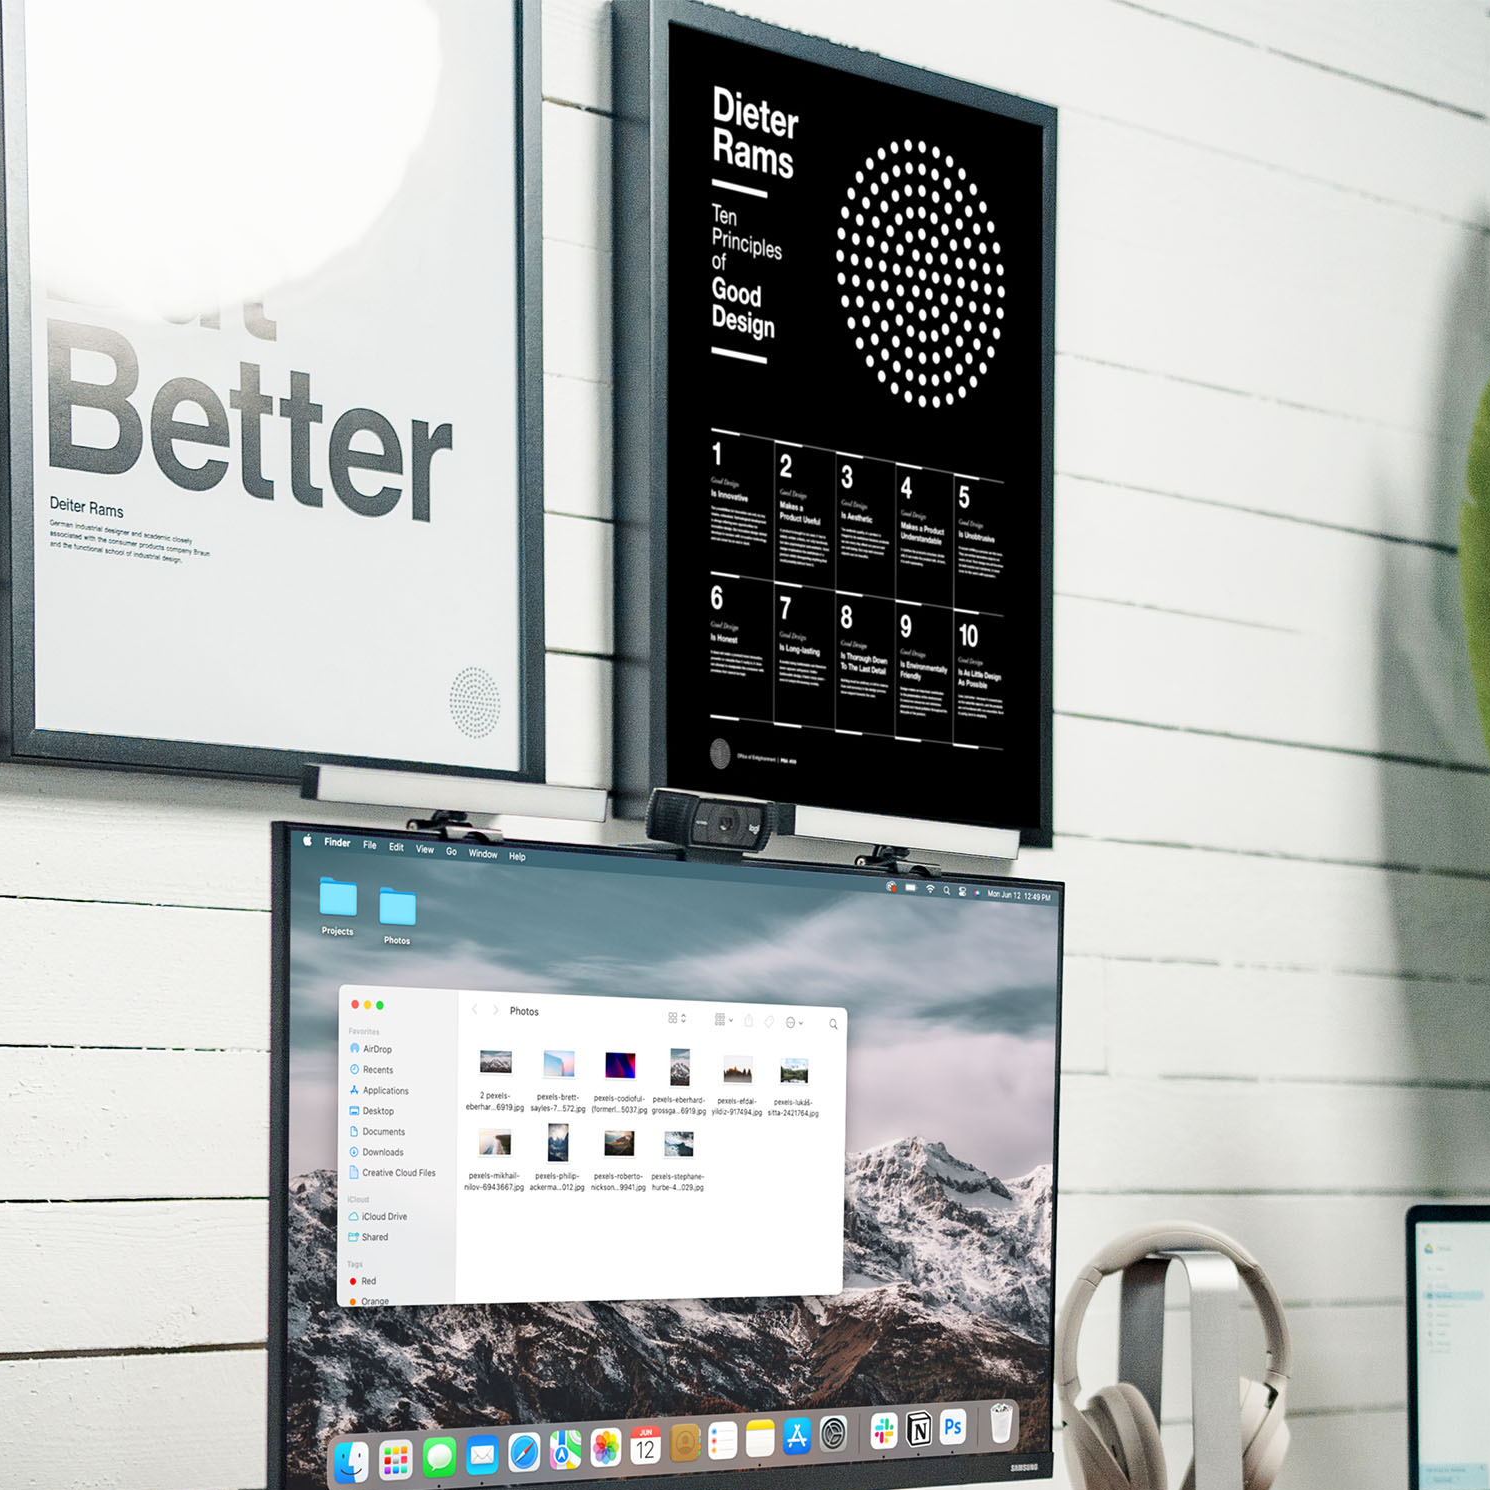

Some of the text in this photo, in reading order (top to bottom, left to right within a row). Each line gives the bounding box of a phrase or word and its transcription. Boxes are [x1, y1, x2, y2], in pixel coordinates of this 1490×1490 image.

[713, 85, 798, 139] Dieter
[713, 126, 793, 178] Rams
[711, 203, 736, 226] Ten
[712, 226, 782, 260] Principles
[711, 253, 726, 270] of
[712, 276, 761, 307] Good
[712, 303, 774, 340] Design
[47, 317, 453, 524] Better
[712, 441, 720, 465] 1
[780, 453, 791, 477] 2
[841, 464, 852, 488] 3
[900, 476, 912, 498] 4
[710, 488, 748, 502] Is Innovative
[958, 485, 969, 508] 5
[50, 495, 123, 518] Deiter Rams
[779, 500, 798, 510] Makes
[779, 511, 820, 525] Product Useful
[840, 511, 872, 523] Is Aesthetic
[900, 521, 918, 531] Makes
[923, 525, 944, 535] Product
[900, 531, 941, 545] Understandable
[710, 585, 722, 609] 6
[779, 595, 791, 619] 7
[840, 604, 852, 628] 8
[900, 614, 911, 637] 9
[710, 633, 737, 643] Is Honest
[959, 623, 977, 647] 10
[779, 643, 820, 657] Is Long-lasting
[840, 651, 887, 664] Is Thorough Down
[840, 661, 886, 674] To The Last Detail
[900, 660, 947, 674] Is Environmentally
[899, 670, 921, 681] Friendly
[963, 668, 970, 676] As
[970, 670, 983, 678] Little
[983, 671, 1001, 682] Design
[957, 678, 987, 689] As Possible
[323, 836, 526, 862] Finder File Edit View Go Window Help
[987, 889, 1000, 897] Mon
[1013, 891, 1020, 899] 12
[1024, 892, 1040, 901] 12:49
[1041, 893, 1050, 901] PM
[321, 926, 353, 936] Projects
[383, 935, 410, 944] Photos
[509, 1006, 539, 1016] Photos
[348, 1027, 379, 1035] Favorites
[363, 1044, 392, 1054] AirDrop
[363, 1065, 393, 1074] Recents
[363, 1086, 409, 1095] Applications
[479, 1091, 484, 1099] 2
[536, 1092, 579, 1100] pexels-brett-
[652, 1095, 705, 1103] pexels-eberhard-
[362, 1106, 394, 1116] Desktop
[362, 1127, 405, 1136] Documents
[362, 1147, 403, 1156] Downloads
[362, 1168, 436, 1177] Creative Cloud Files
[468, 1171, 519, 1179] pexels-mikhail-
[535, 1172, 579, 1180] pexels-philip-
[593, 1172, 643, 1180] pexels-roberto-
[651, 1172, 704, 1180] pexels-stephane-
[463, 1182, 524, 1192] nilov-6943667.jpg
[347, 1195, 369, 1203] iCloud
[361, 1211, 407, 1220] iCloud Drive
[361, 1232, 388, 1241] Shared
[347, 1260, 362, 1269] Tags
[361, 1276, 376, 1285] Red
[361, 1296, 389, 1306] Orange
[945, 1418, 962, 1435] Ps
[639, 1429, 653, 1437] JUN
[637, 1440, 654, 1459] 12
